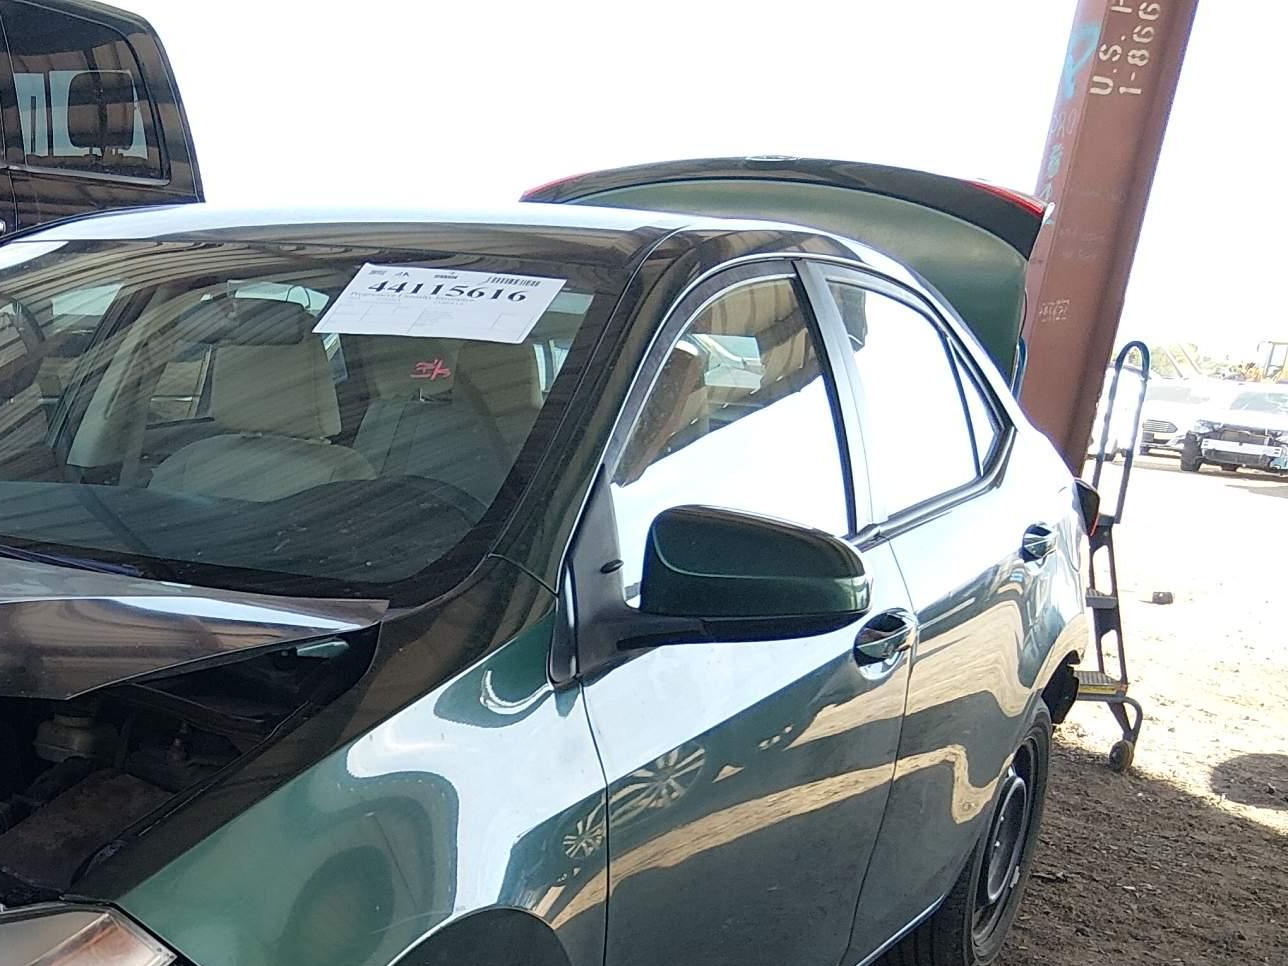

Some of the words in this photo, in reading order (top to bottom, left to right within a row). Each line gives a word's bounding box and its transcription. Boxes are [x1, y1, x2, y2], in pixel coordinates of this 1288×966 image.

[1089, 35, 1126, 95] U.S.
[1119, 2, 1161, 95] 1-866
[368, 280, 528, 301] 44115616
